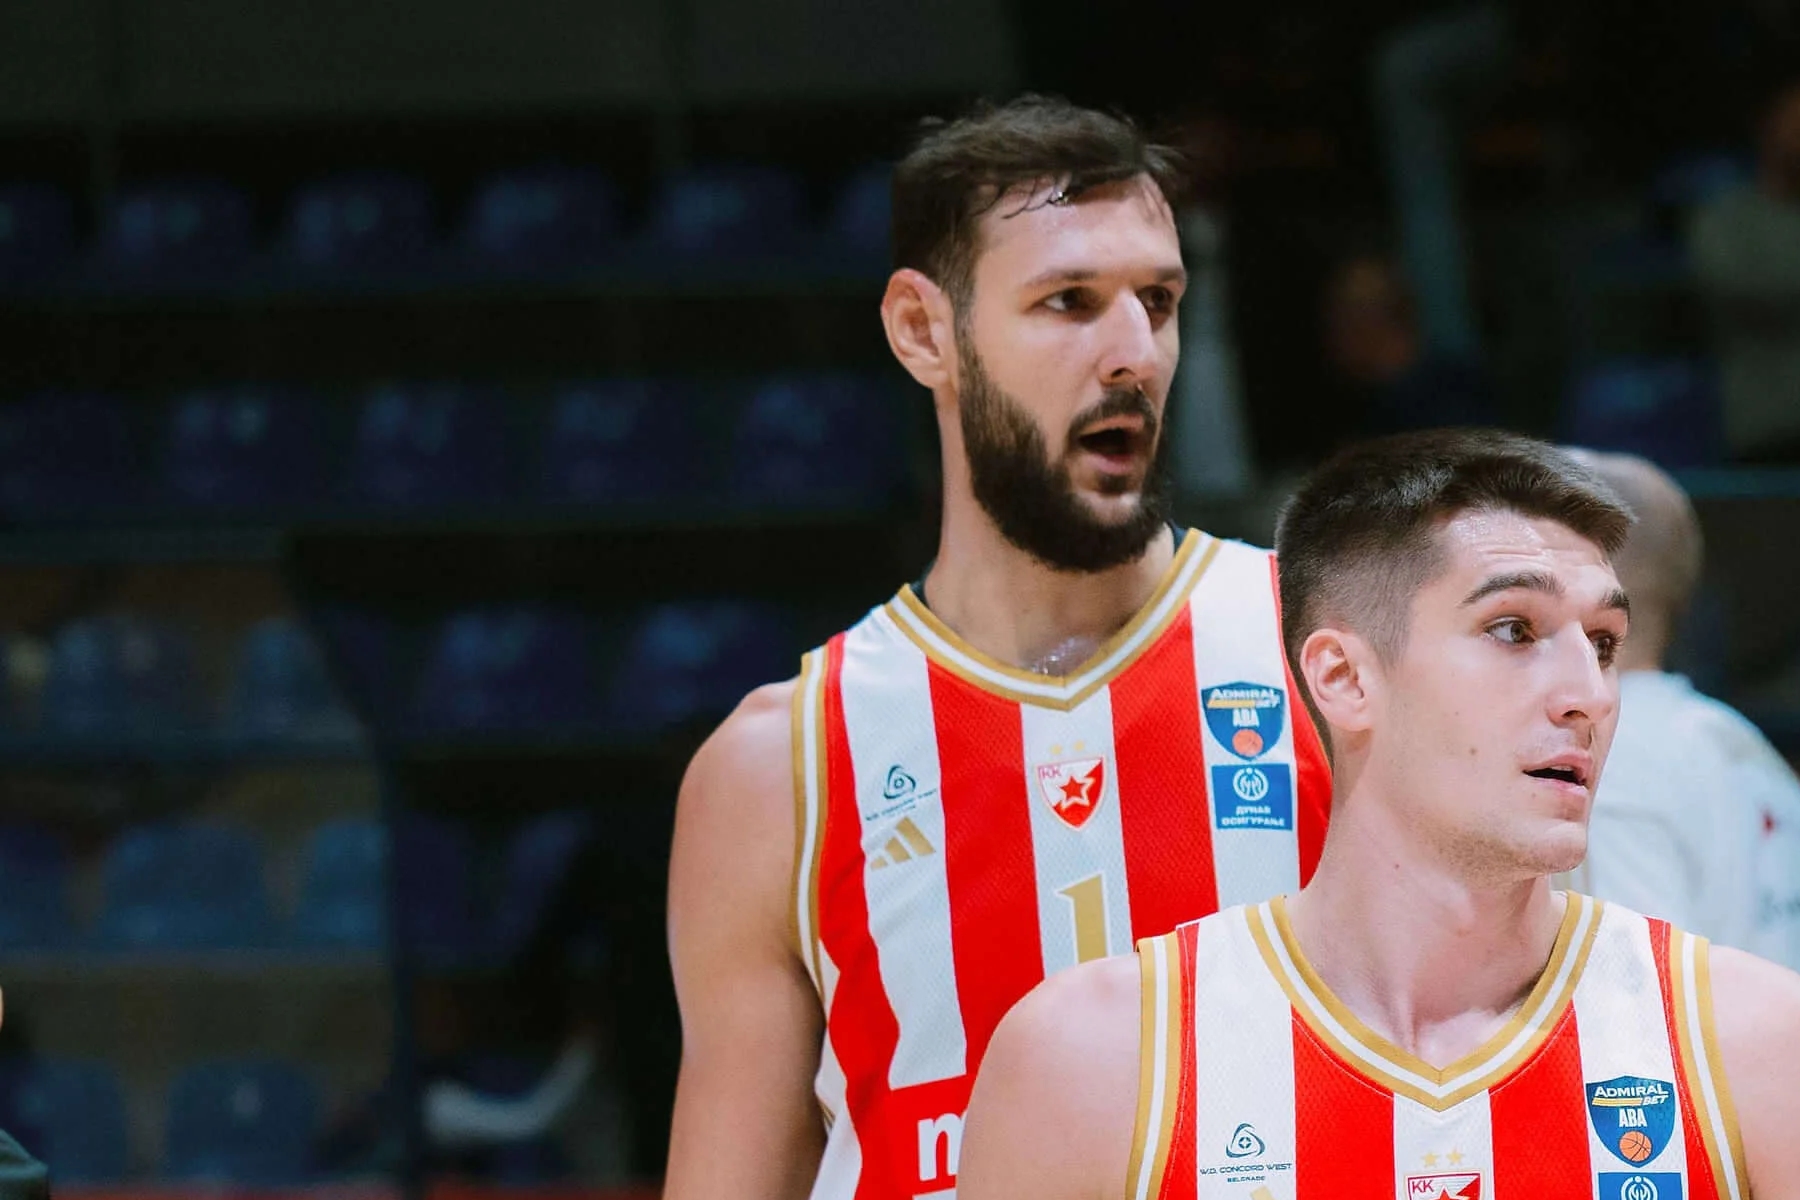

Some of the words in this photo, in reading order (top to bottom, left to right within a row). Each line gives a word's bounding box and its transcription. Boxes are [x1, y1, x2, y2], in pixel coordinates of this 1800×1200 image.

[1594, 1083, 1669, 1098] ADMIRAL
[1642, 1095, 1669, 1106] BET
[1618, 1108, 1648, 1128] ABA
[1266, 1163, 1292, 1171] WEST
[1412, 1180, 1434, 1193] KK
